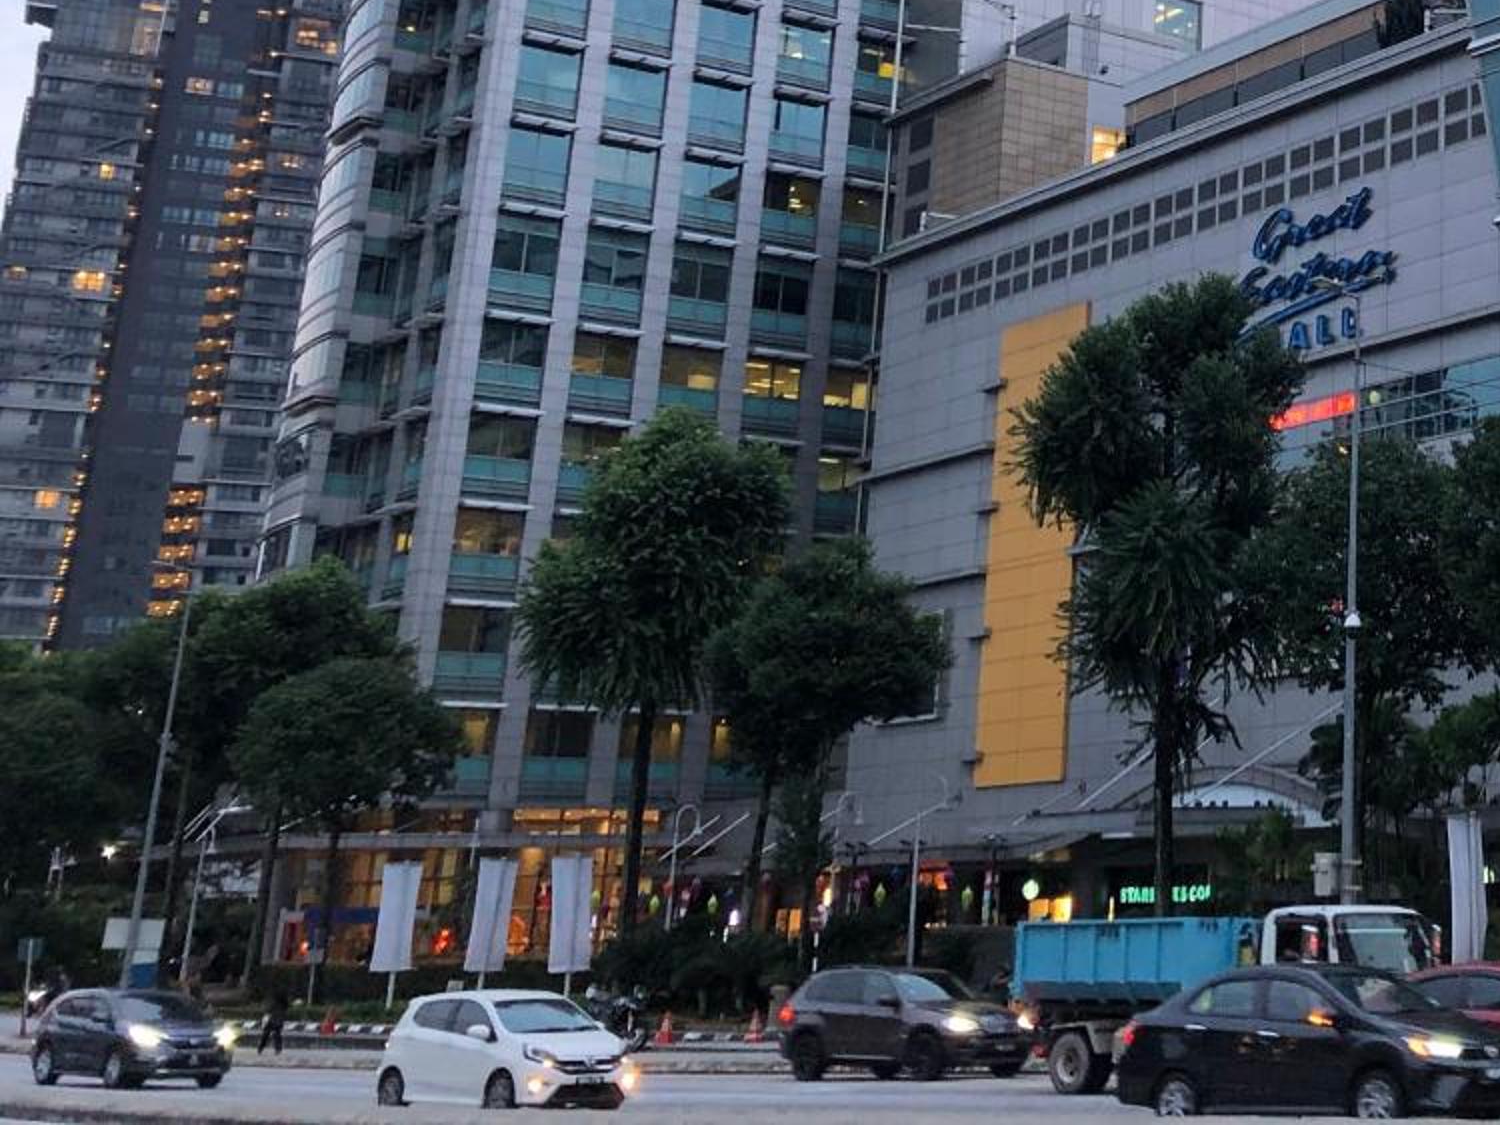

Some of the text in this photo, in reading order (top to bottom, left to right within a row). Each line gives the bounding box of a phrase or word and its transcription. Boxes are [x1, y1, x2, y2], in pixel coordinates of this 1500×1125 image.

[1253, 186, 1374, 264] Great
[1240, 251, 1399, 304] Eastern
[1119, 886, 1187, 904] STARBKS
